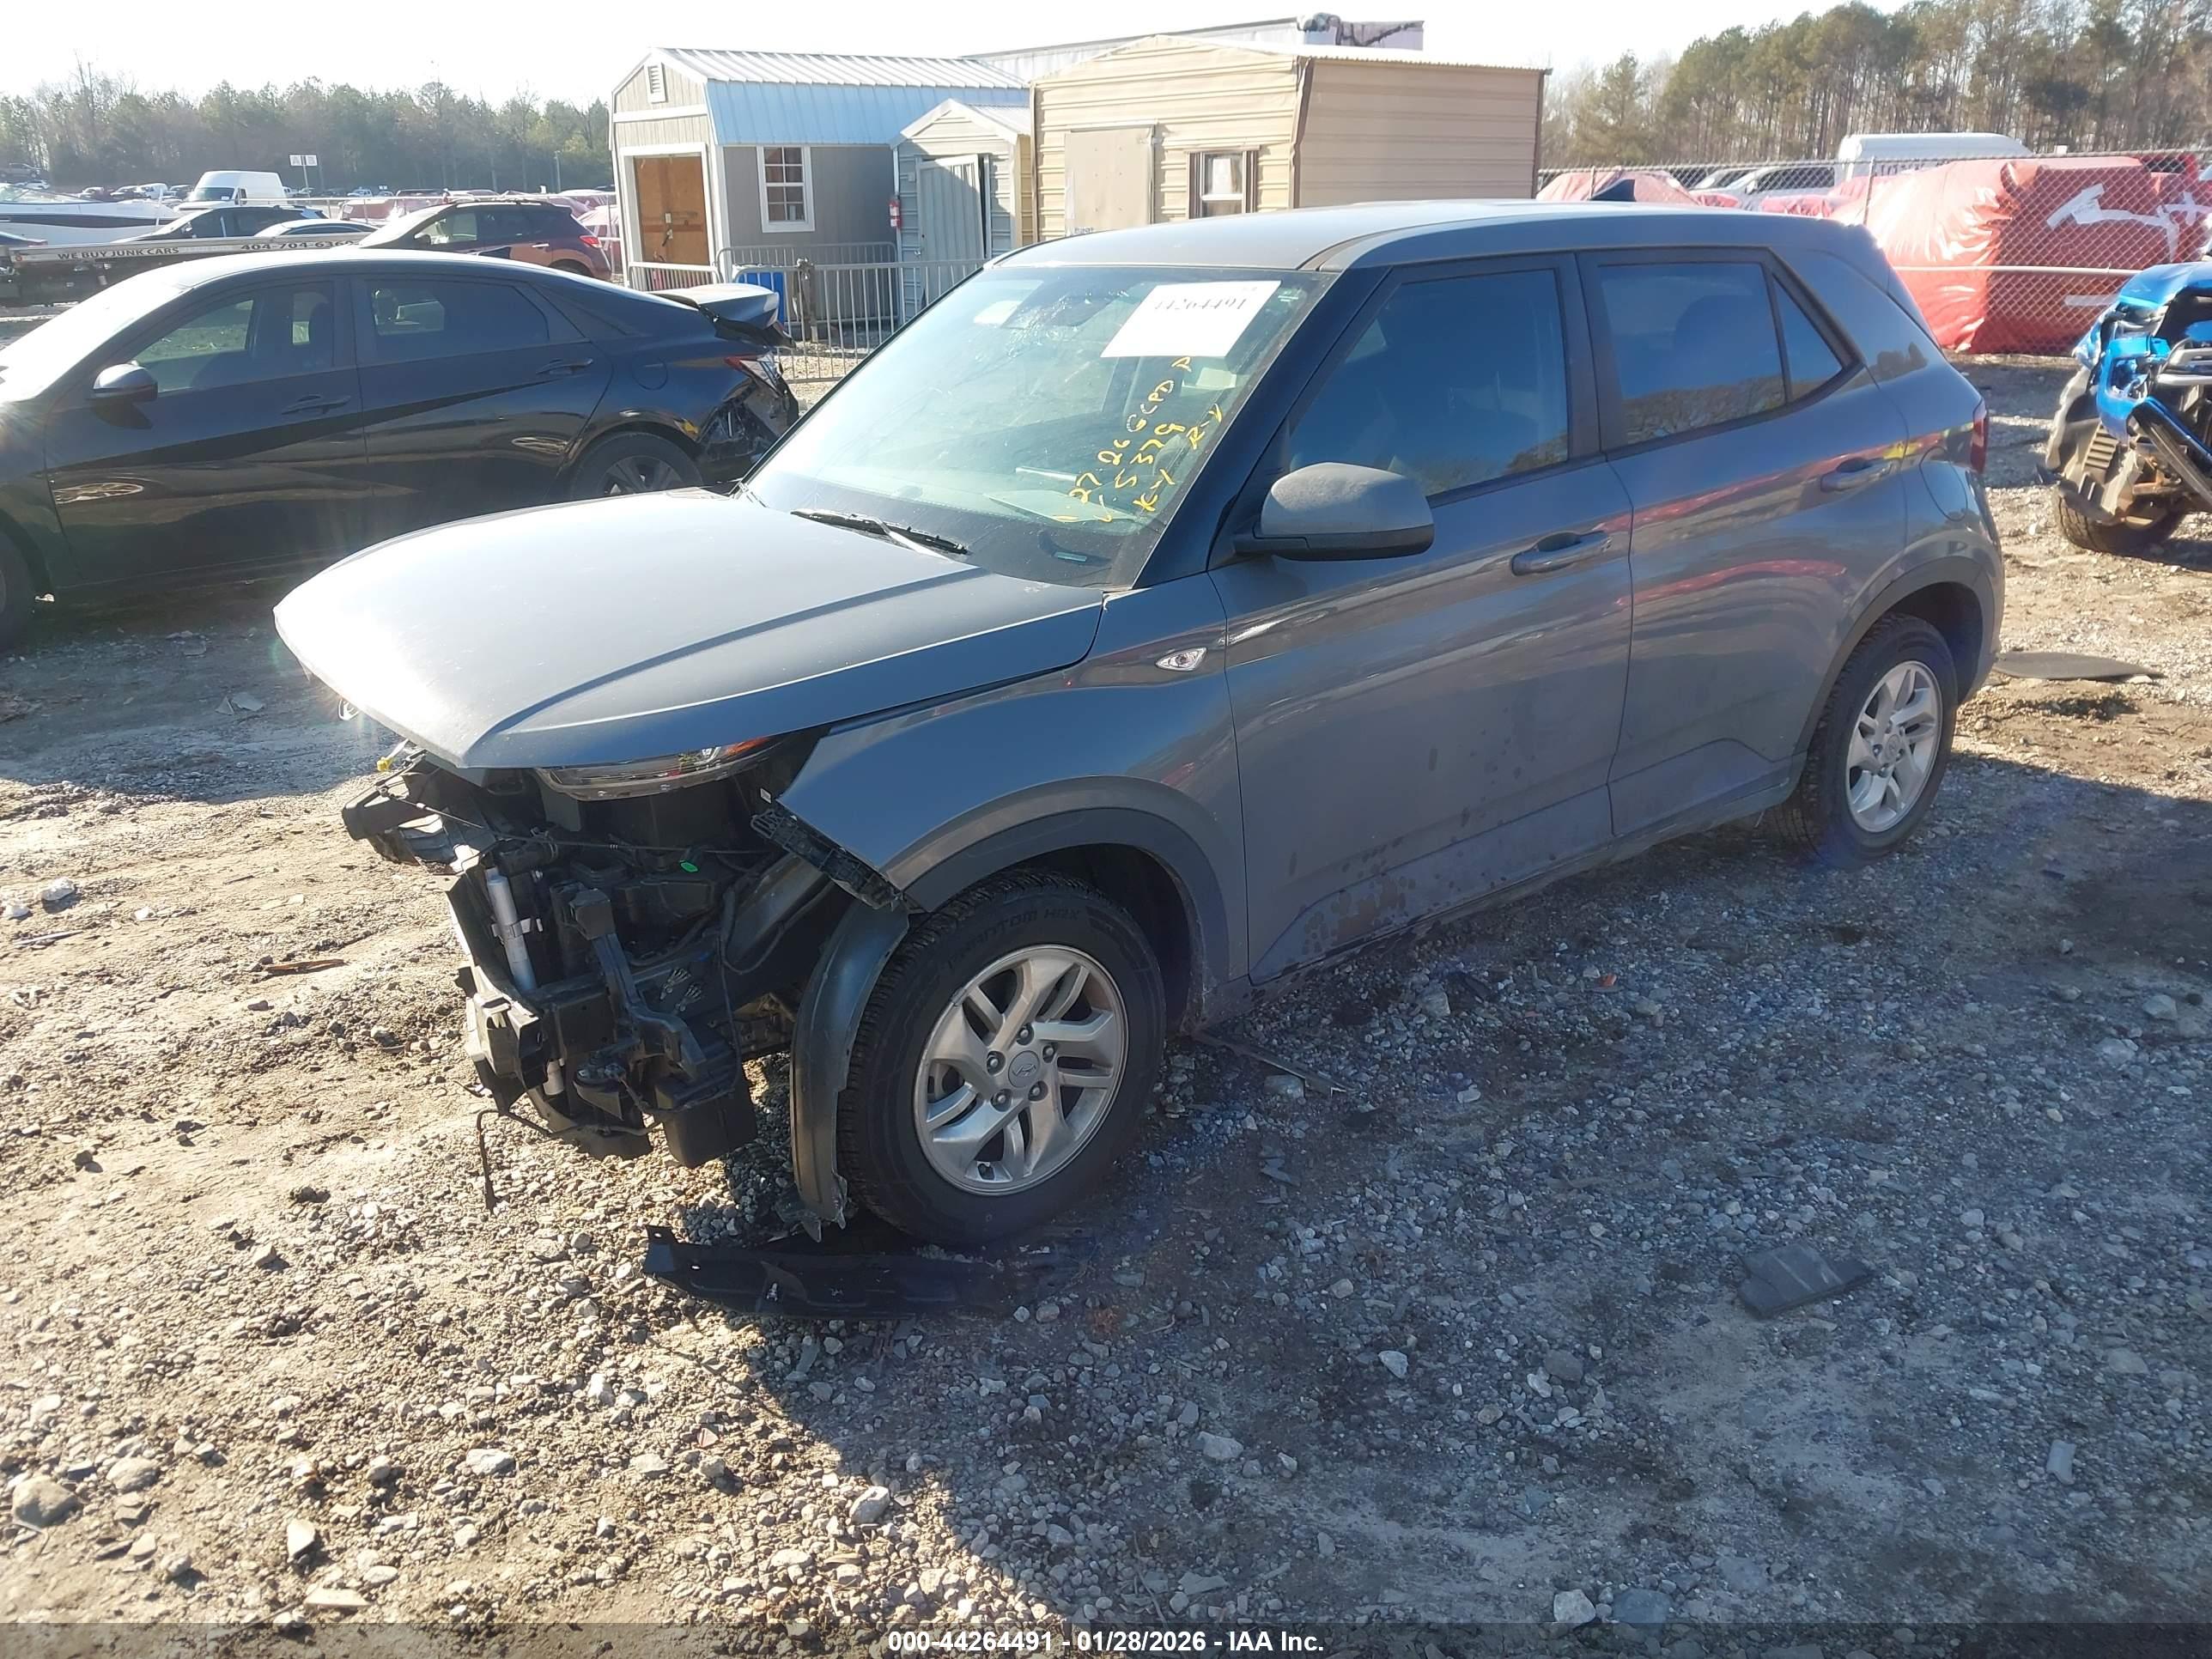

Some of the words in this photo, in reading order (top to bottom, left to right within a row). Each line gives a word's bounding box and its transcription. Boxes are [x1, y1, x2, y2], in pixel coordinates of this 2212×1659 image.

[241, 240, 360, 251] 404-704-636
[111, 249, 143, 258] JUNK
[147, 247, 179, 256] CARS
